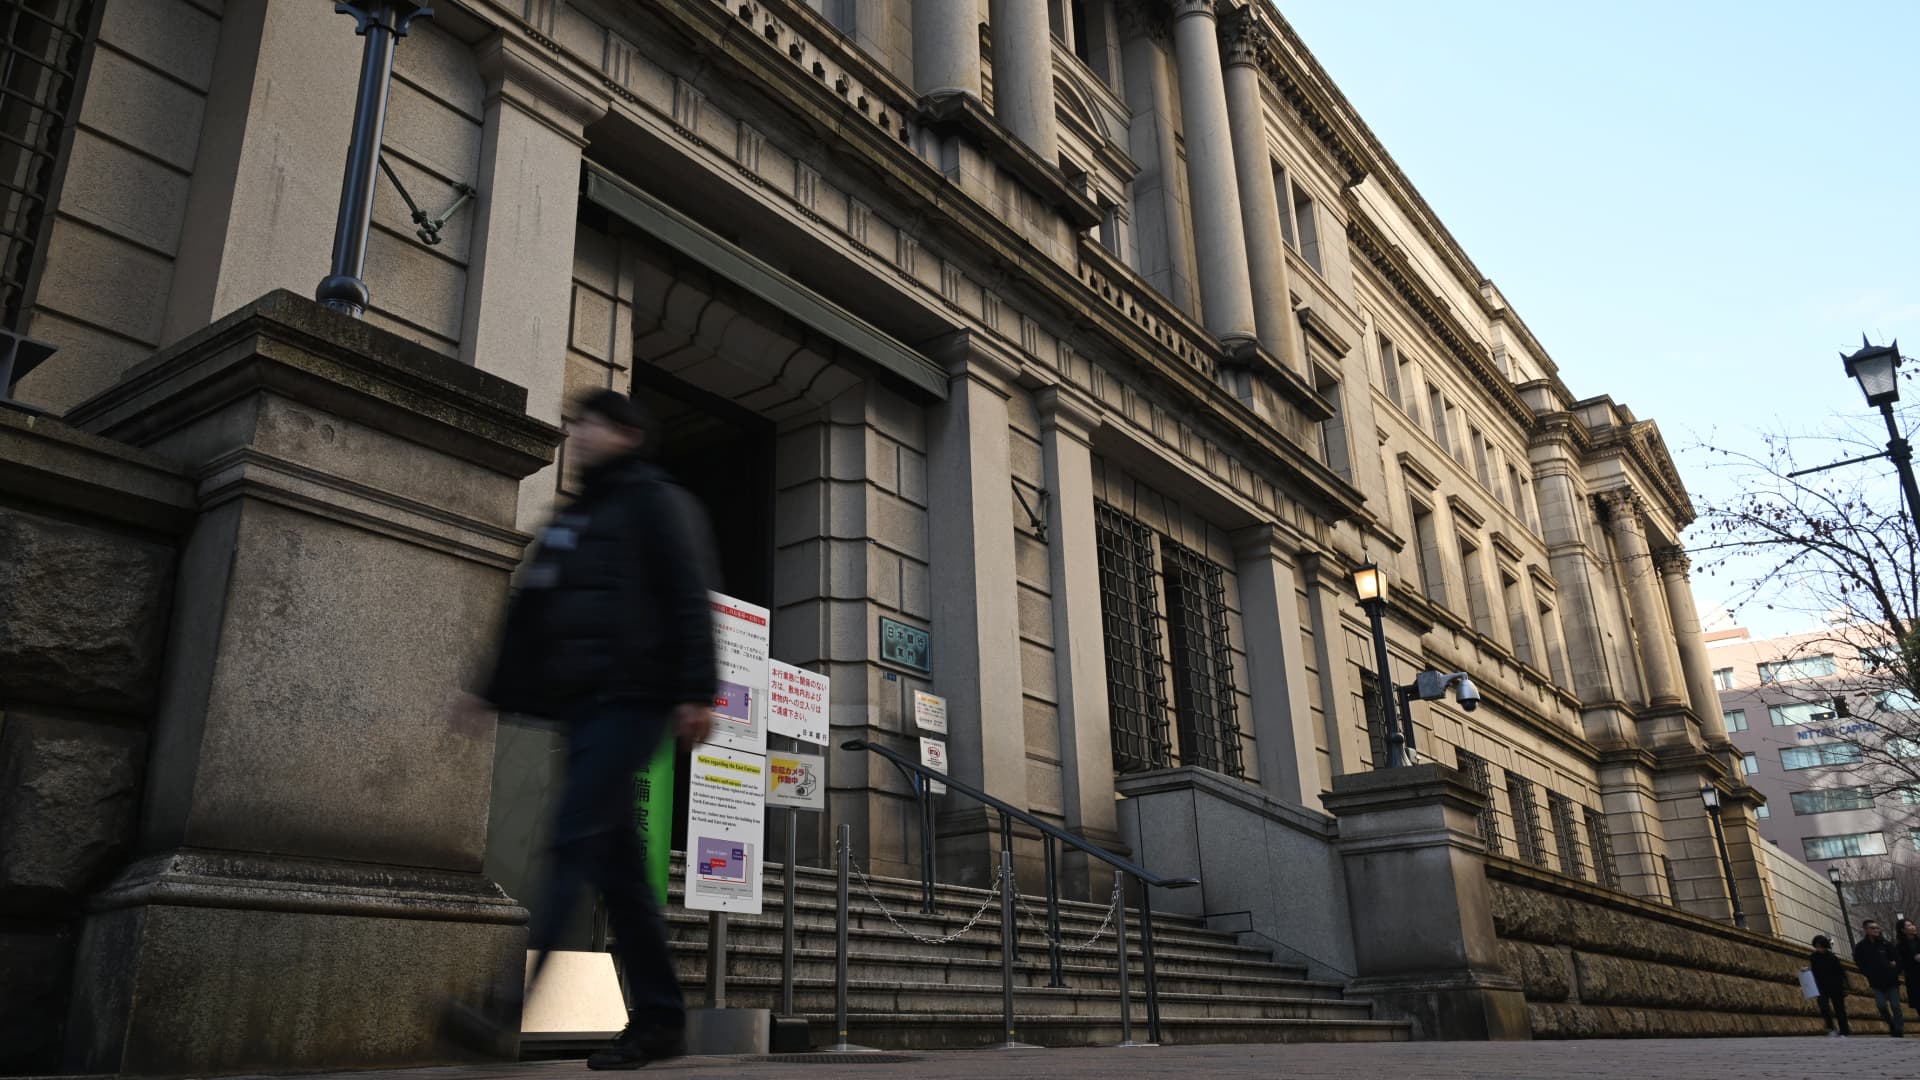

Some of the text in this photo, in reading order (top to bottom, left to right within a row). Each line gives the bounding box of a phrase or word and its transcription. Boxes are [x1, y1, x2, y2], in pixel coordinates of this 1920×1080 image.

[772, 668, 827, 691] 本行業務に関係のない
[771, 692, 822, 714] 建物内への立入りは
[772, 705, 807, 723] ご遠慮下さい。
[802, 729, 827, 743] 日本銀行
